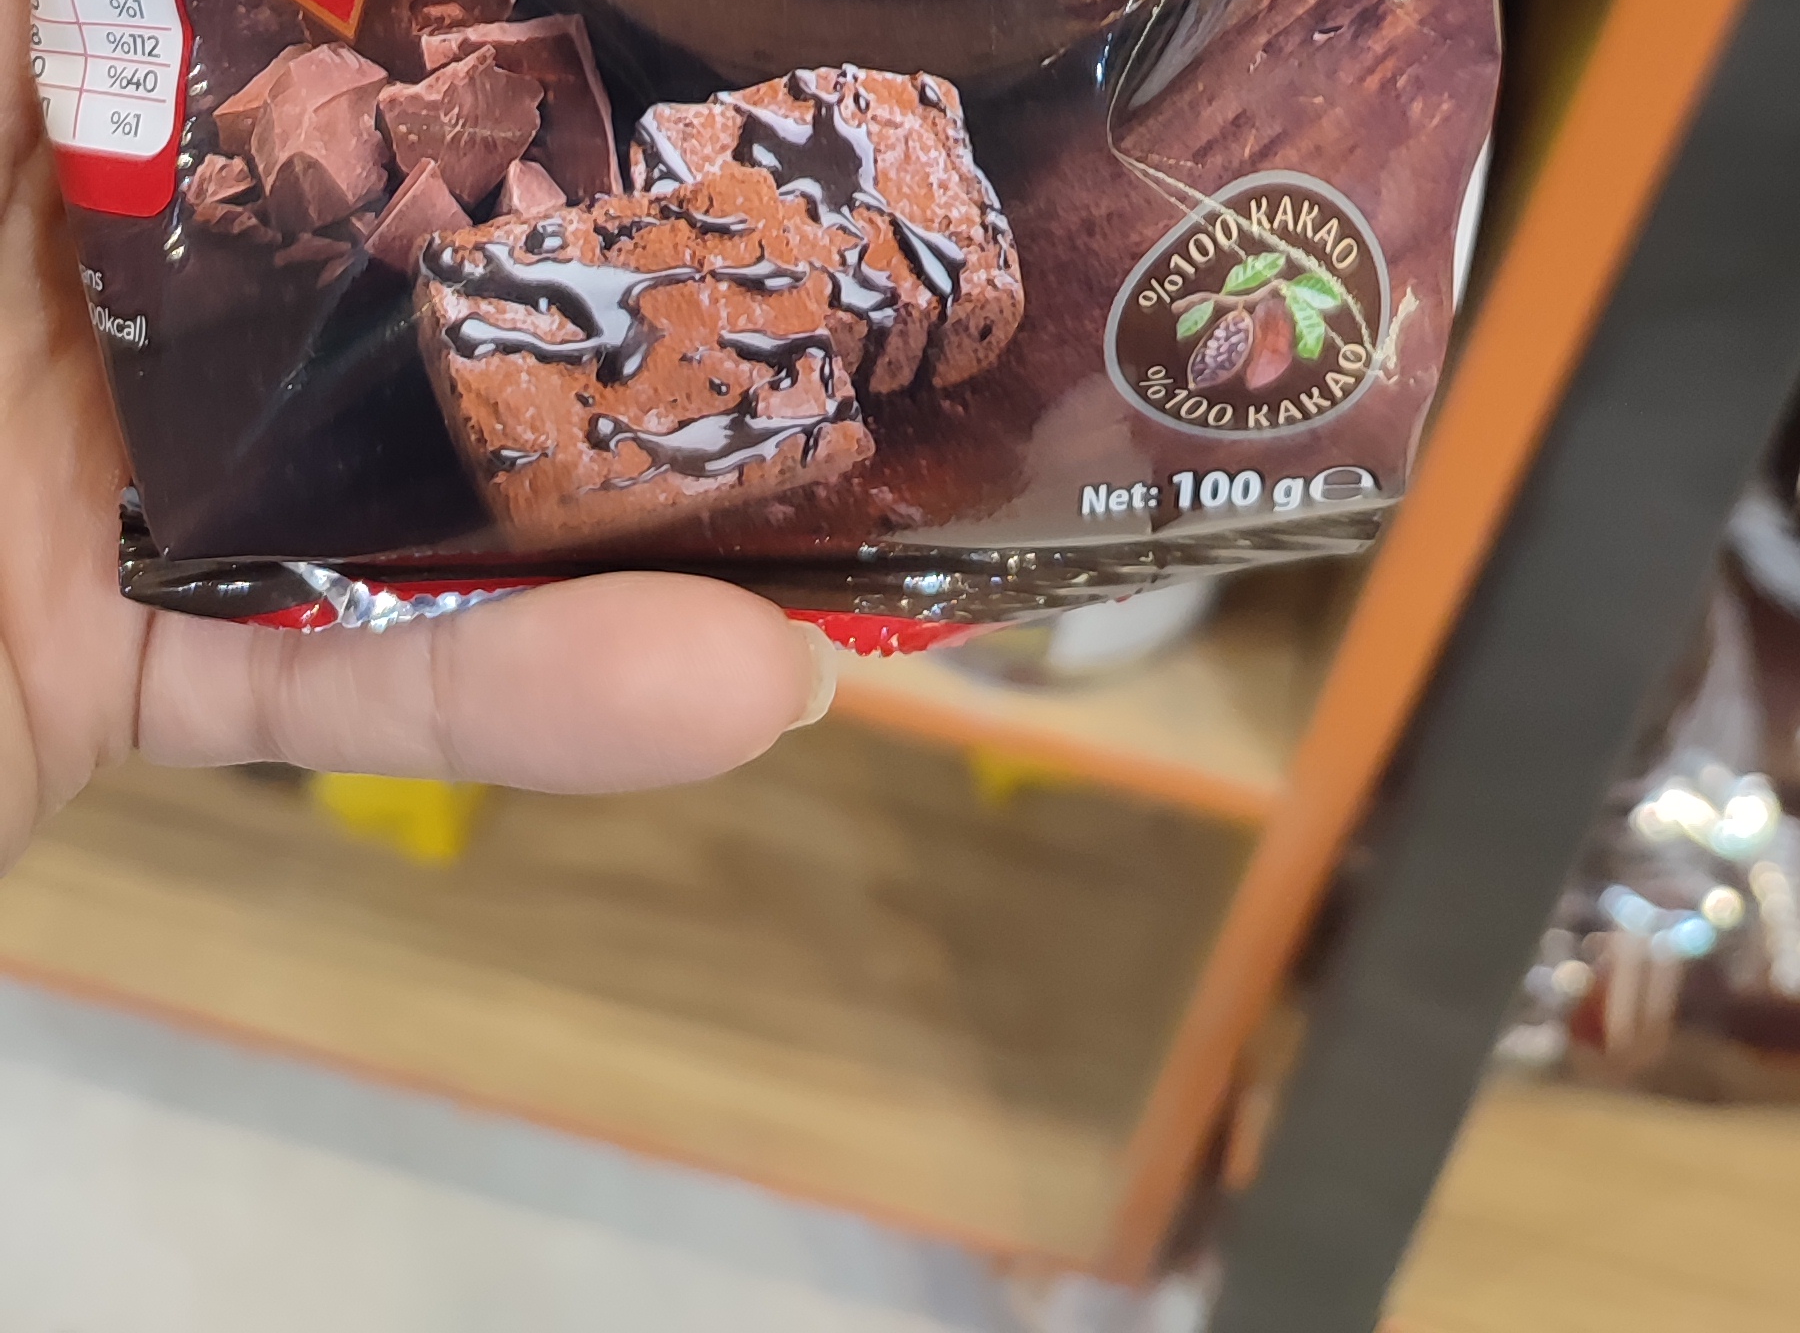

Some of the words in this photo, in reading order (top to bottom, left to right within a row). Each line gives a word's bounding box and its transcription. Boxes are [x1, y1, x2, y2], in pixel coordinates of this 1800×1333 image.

[105, 31, 162, 58] %112
[106, 64, 159, 94] %40
[110, 110, 142, 138] %1
[1137, 213, 1239, 308] %100
[1249, 195, 1359, 271] KAKAO
[1138, 365, 1234, 427] %100
[1248, 342, 1368, 429] KAKAO
[1081, 481, 1160, 516] Net:
[1172, 469, 1264, 511] 100
[1272, 476, 1305, 512] g
